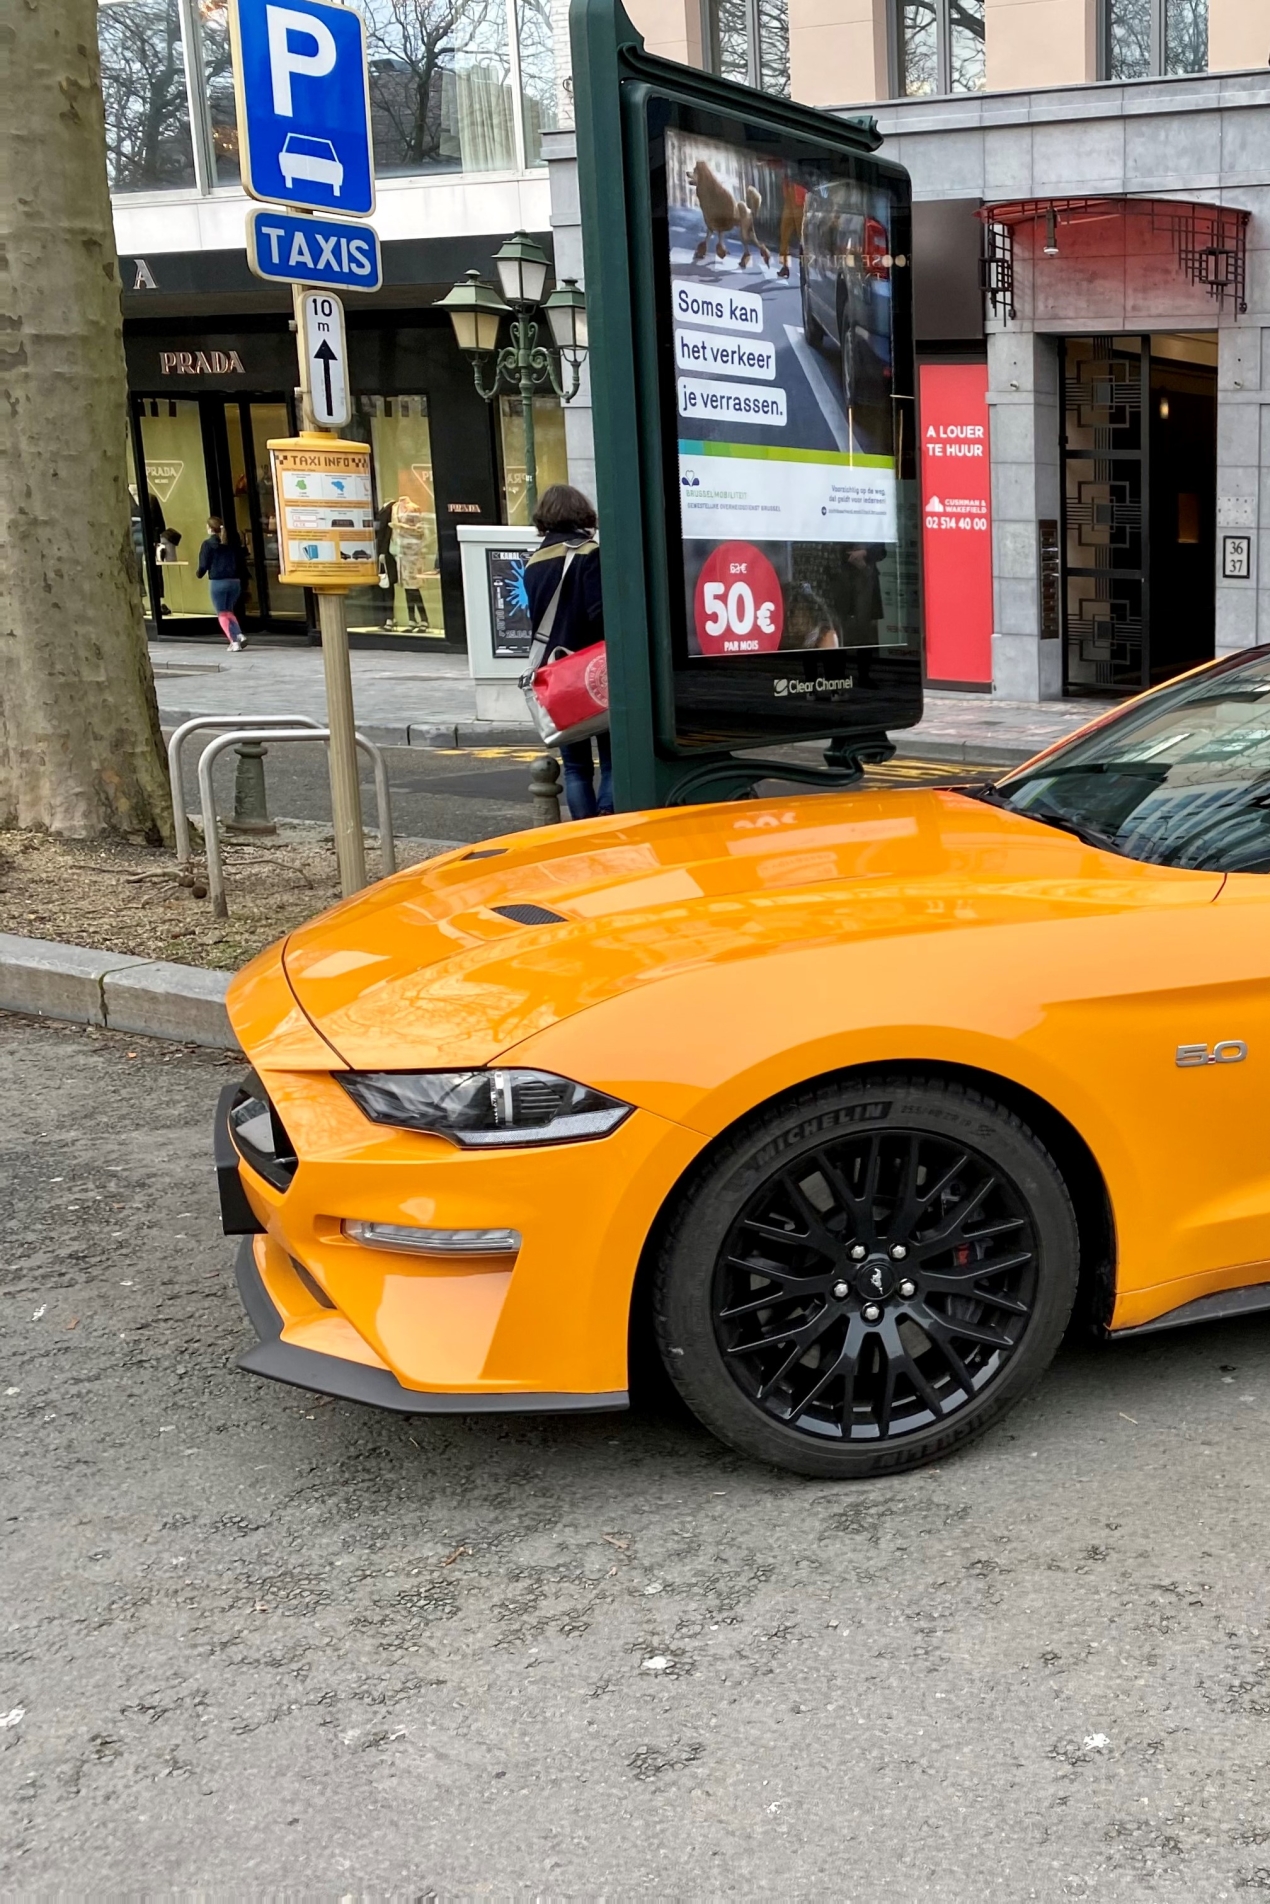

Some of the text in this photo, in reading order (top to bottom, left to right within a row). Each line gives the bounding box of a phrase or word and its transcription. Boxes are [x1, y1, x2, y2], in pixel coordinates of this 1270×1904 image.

[266, 4, 337, 117] P
[261, 226, 371, 275] TAXIS
[312, 298, 333, 317] 10
[678, 289, 759, 324] Soms kan
[317, 322, 330, 332] m
[681, 336, 772, 370] het verkeer
[159, 350, 246, 375] PRADA
[682, 384, 784, 416] je verrassen.
[926, 425, 984, 438] A LOUER
[926, 443, 983, 457] TE HUUR
[290, 455, 350, 467] TAXI INFO
[447, 503, 481, 513] PRADA
[945, 498, 980, 506] CUSHMAN
[945, 506, 987, 514] WAKEFIELD
[926, 516, 987, 530] 02 514 40 00
[1229, 541, 1244, 555] 36
[1229, 559, 1243, 573] 37
[703, 581, 775, 636] 50€
[724, 640, 759, 652] PAR MOIS
[789, 676, 853, 693] Clear Channel
[1176, 1040, 1248, 1068] 5.0
[755, 1103, 884, 1166] MICHELIN
